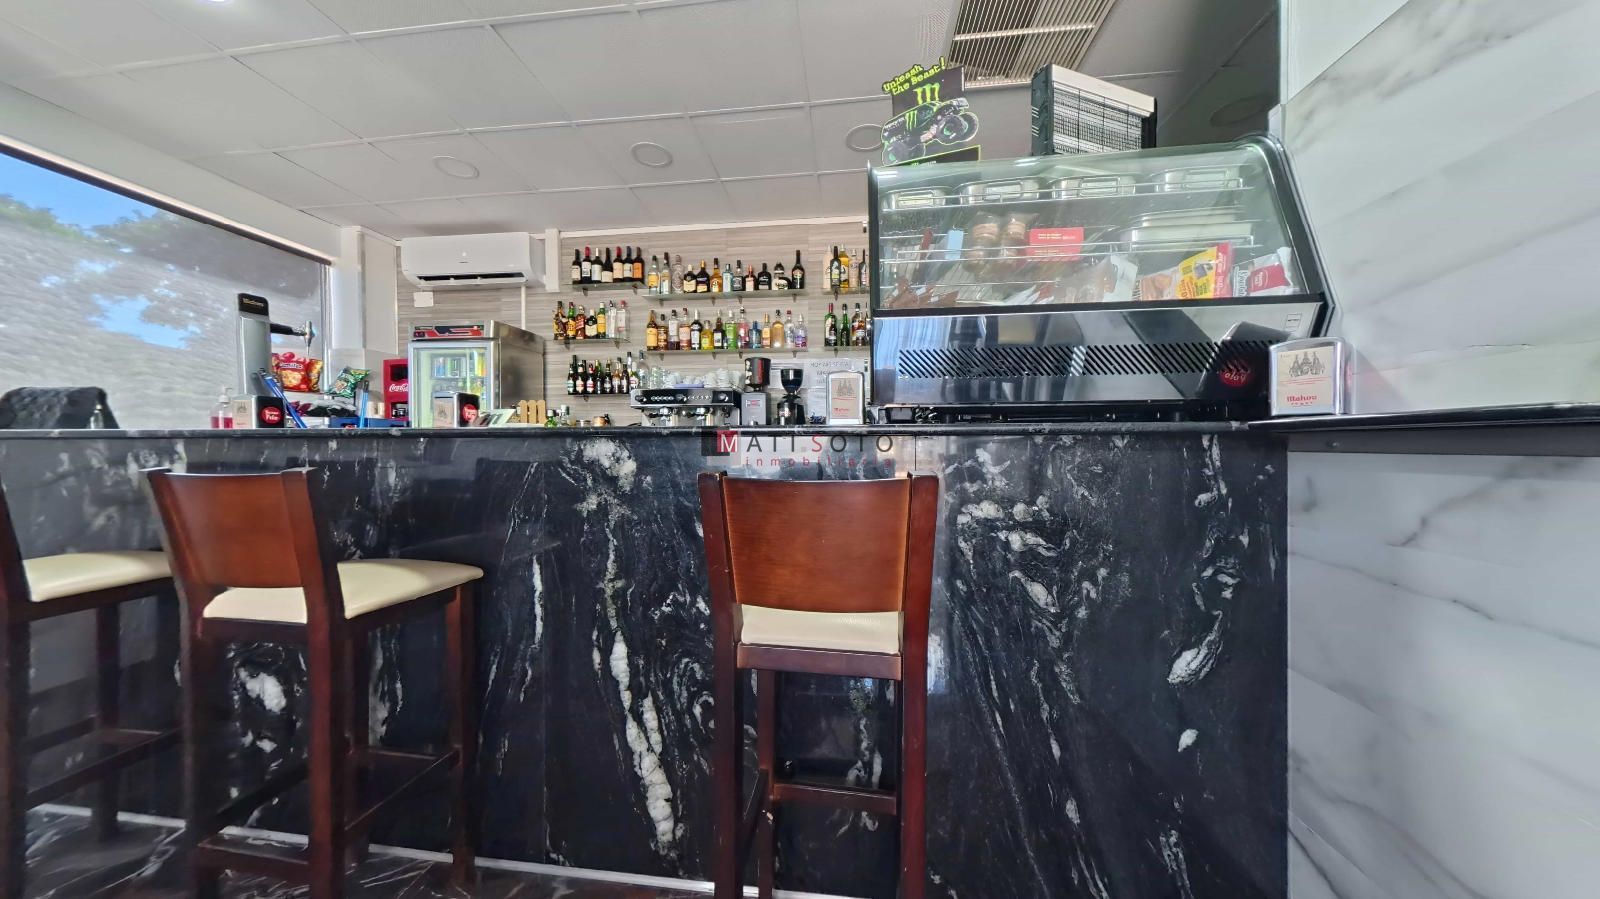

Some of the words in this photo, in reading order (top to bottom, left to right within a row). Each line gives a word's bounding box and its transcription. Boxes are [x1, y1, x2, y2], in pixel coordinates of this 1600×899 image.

[892, 82, 910, 95] the
[911, 56, 945, 85] Beast!
[1286, 394, 1318, 402] Mahou
